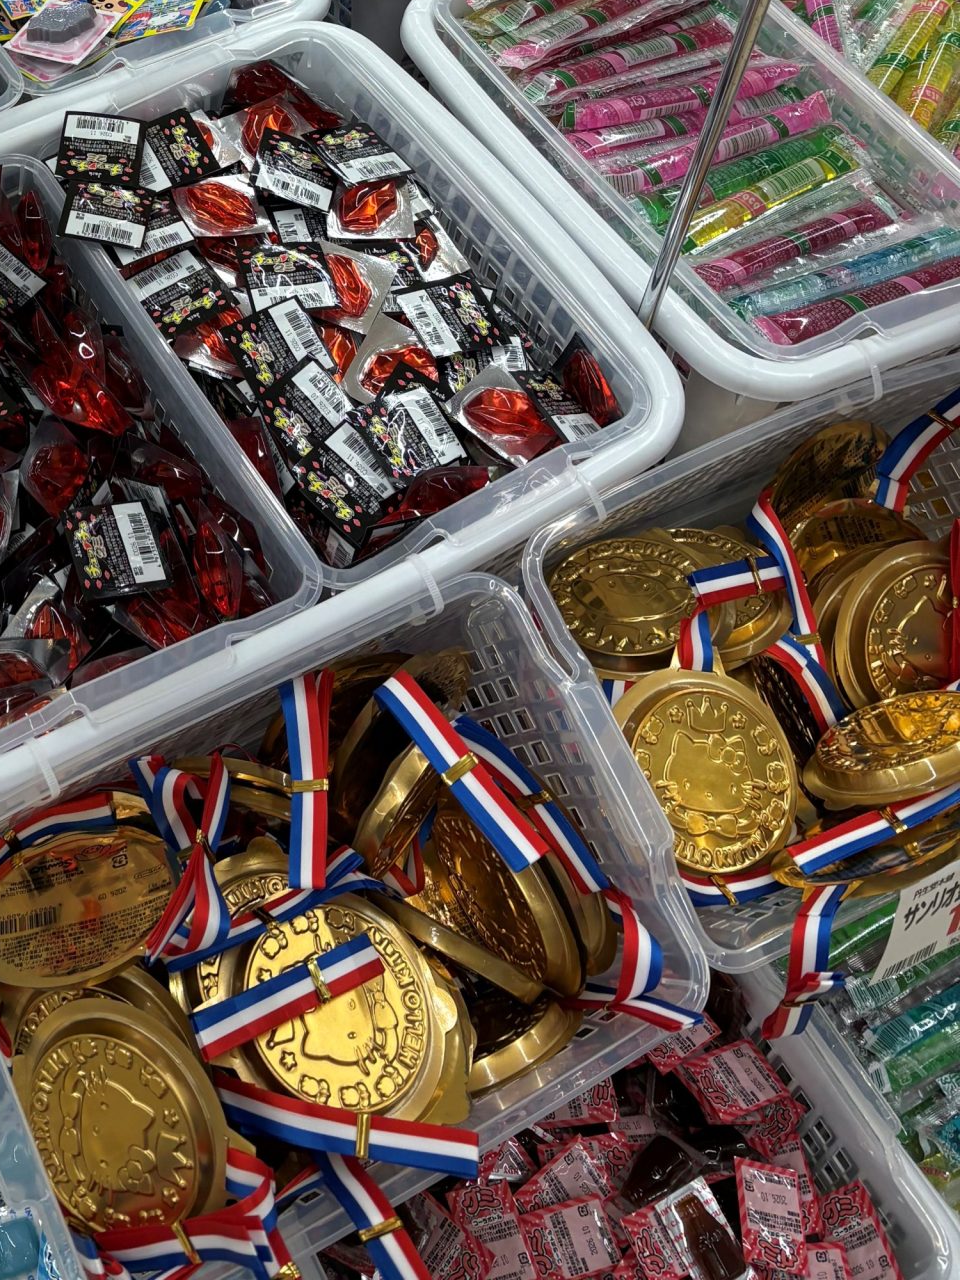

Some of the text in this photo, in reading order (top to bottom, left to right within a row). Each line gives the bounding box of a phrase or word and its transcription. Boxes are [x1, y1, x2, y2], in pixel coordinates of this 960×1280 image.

[903, 880, 960, 932] サンリオ
[399, 988, 424, 1071] HELLO
[459, 1183, 505, 1216] グミ
[819, 1192, 864, 1226] グミ
